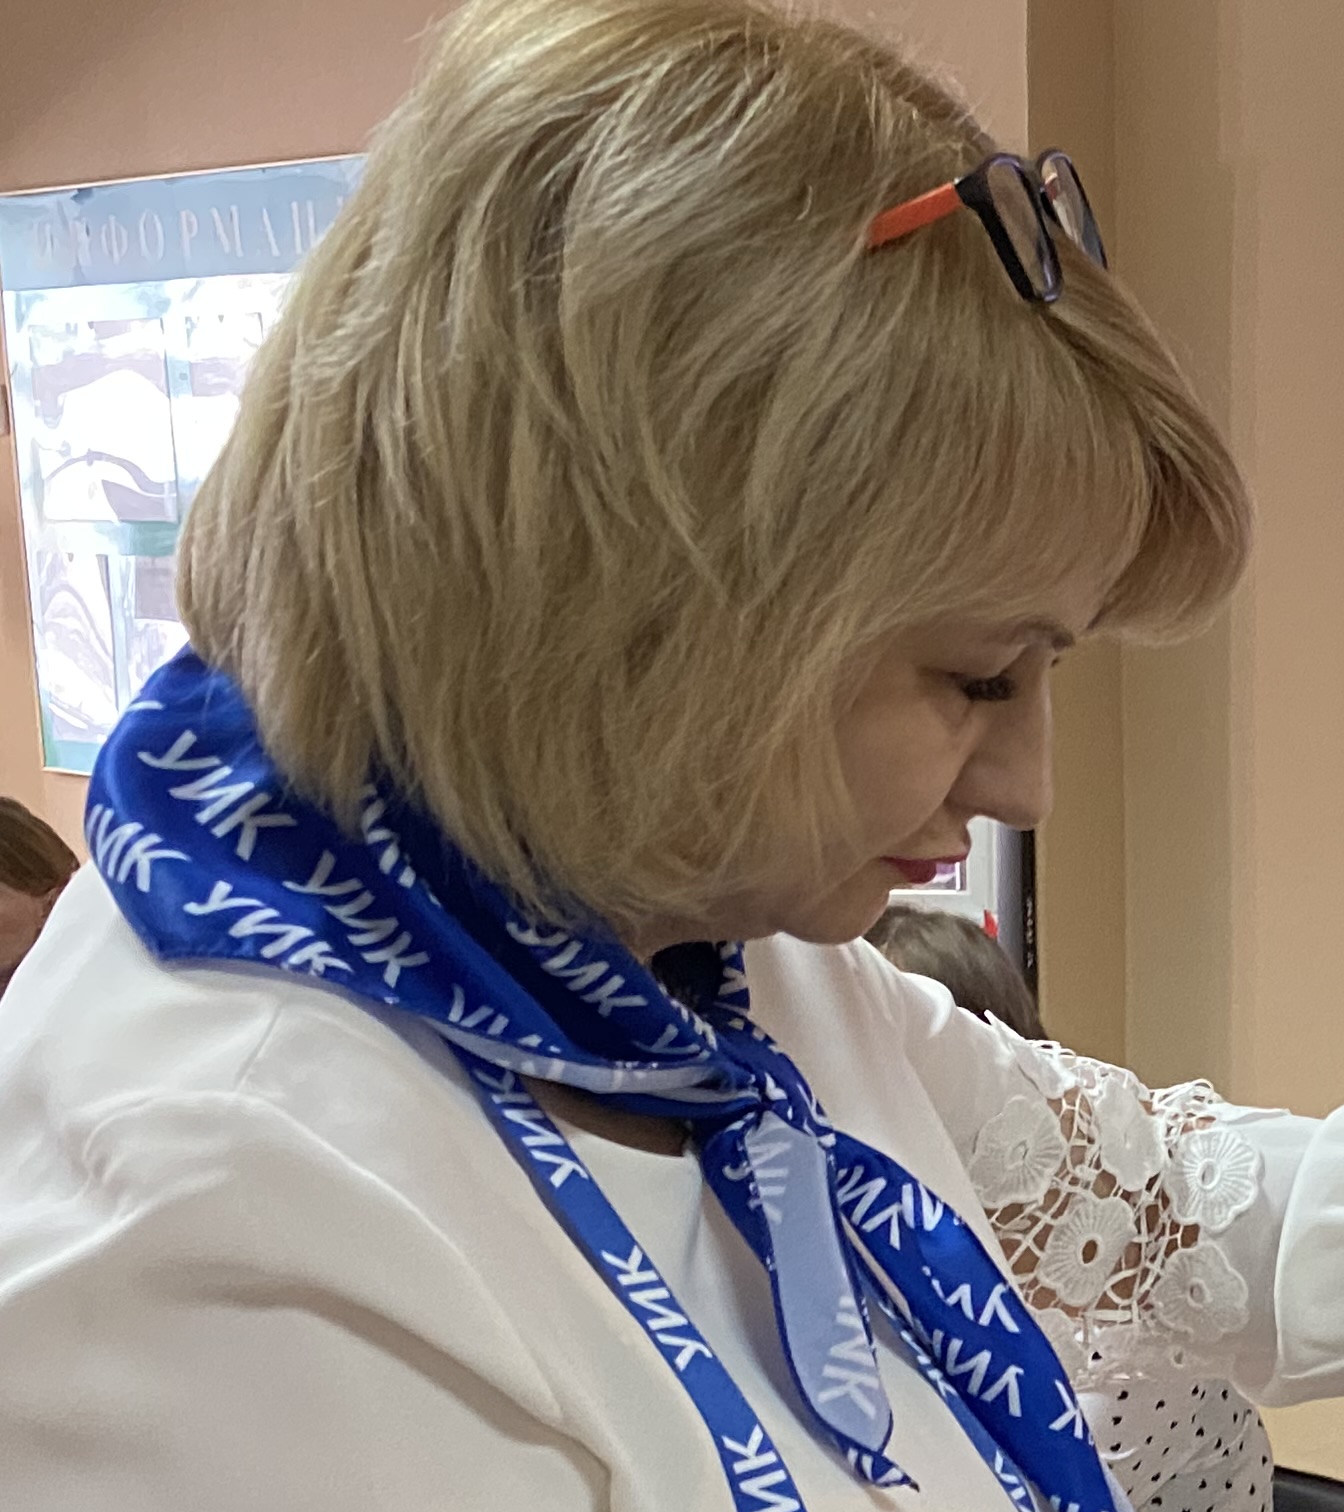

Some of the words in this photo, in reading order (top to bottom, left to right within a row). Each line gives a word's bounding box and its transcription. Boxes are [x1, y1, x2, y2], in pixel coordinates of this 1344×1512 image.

[137, 729, 298, 862] УИК
[183, 880, 354, 976] УИК
[282, 850, 431, 988] УИК
[601, 1245, 713, 1371] УИК
